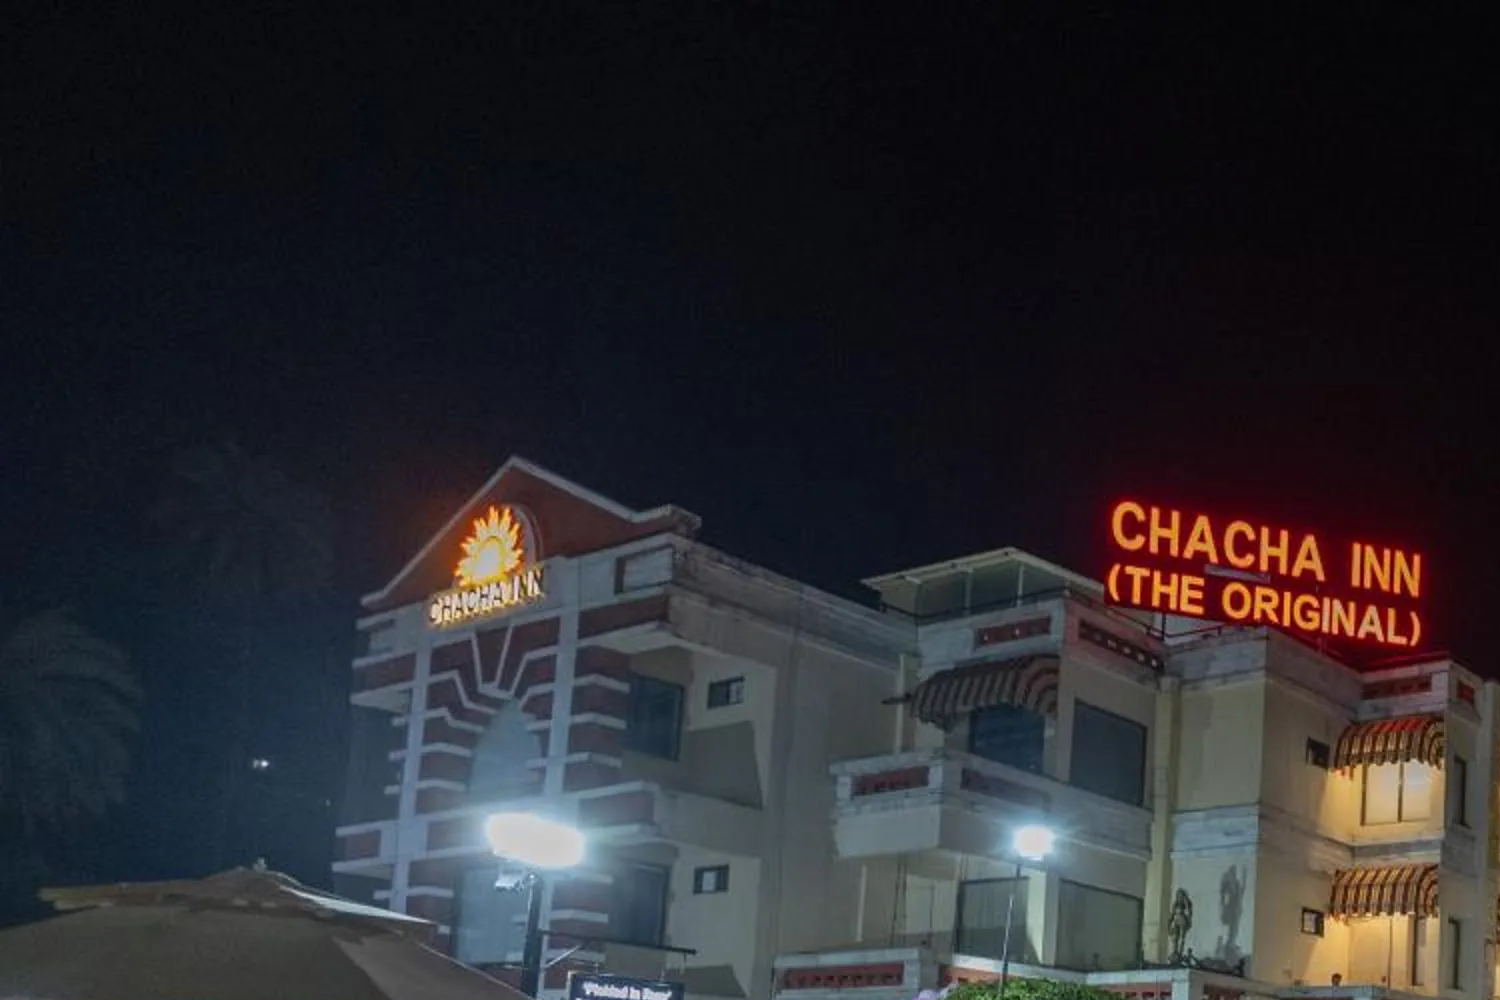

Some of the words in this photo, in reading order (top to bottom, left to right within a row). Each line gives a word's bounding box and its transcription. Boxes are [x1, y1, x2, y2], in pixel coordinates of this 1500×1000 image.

[1111, 501, 1326, 582] CHACHA
[1351, 542, 1422, 598] INN
[1107, 563, 1206, 615] (THE
[1221, 581, 1422, 647] ORIGINAL)
